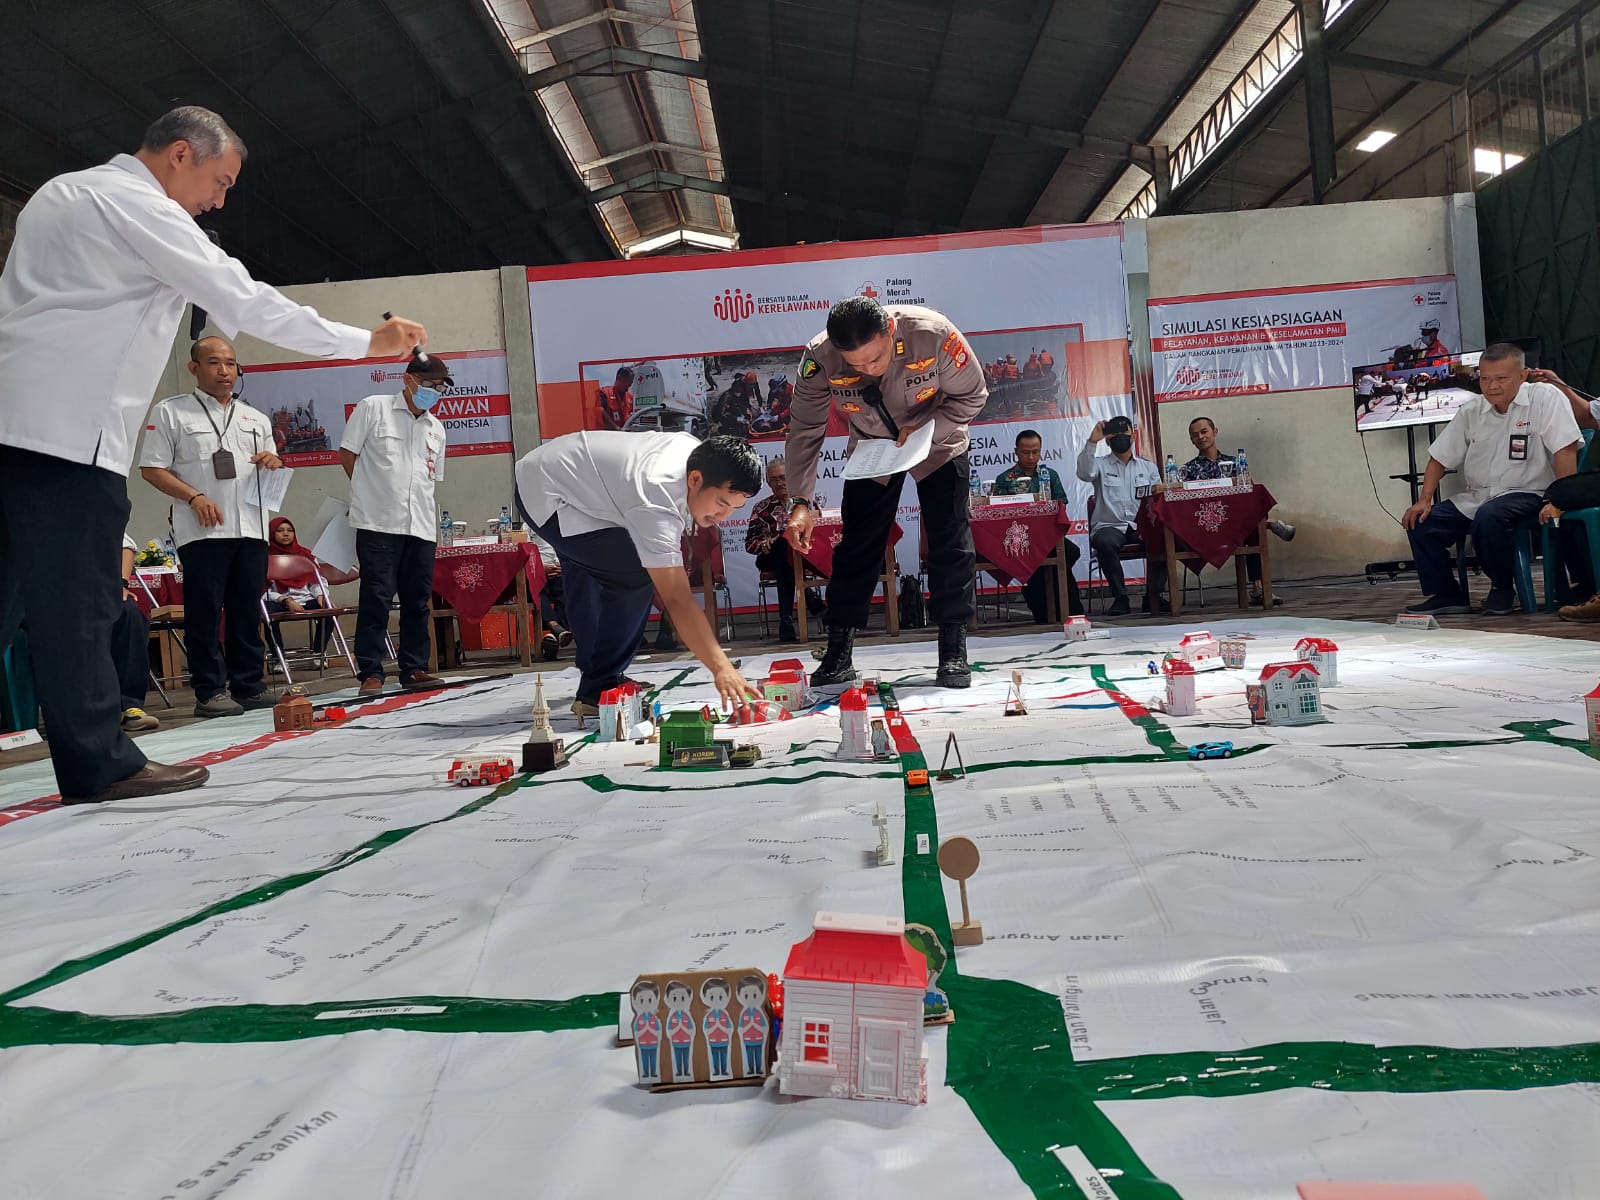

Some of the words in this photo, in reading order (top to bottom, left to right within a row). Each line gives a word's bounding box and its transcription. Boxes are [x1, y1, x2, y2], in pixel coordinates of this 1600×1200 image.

[886, 278, 912, 286] Palang
[886, 288, 910, 296] Merah
[757, 296, 786, 304] BERSATU
[787, 294, 809, 302] DALAM
[758, 300, 830, 314] KERELAWANAN
[1162, 318, 1226, 336] SIMULASI
[1232, 308, 1342, 329] KESIAPSIAGAAN
[1214, 333, 1258, 343] KEAMANAN
[1270, 328, 1324, 339] KESELAMATAN
[906, 370, 938, 387] POLRI
[440, 385, 488, 397] RASEHAN
[690, 930, 737, 938] Jalan
[985, 933, 1060, 942] Anggre
[1070, 934, 1127, 942] Jalan
[1532, 986, 1600, 997] Jalan
[1198, 998, 1226, 1025] Jalan
[1073, 1021, 1093, 1052] Jalan
